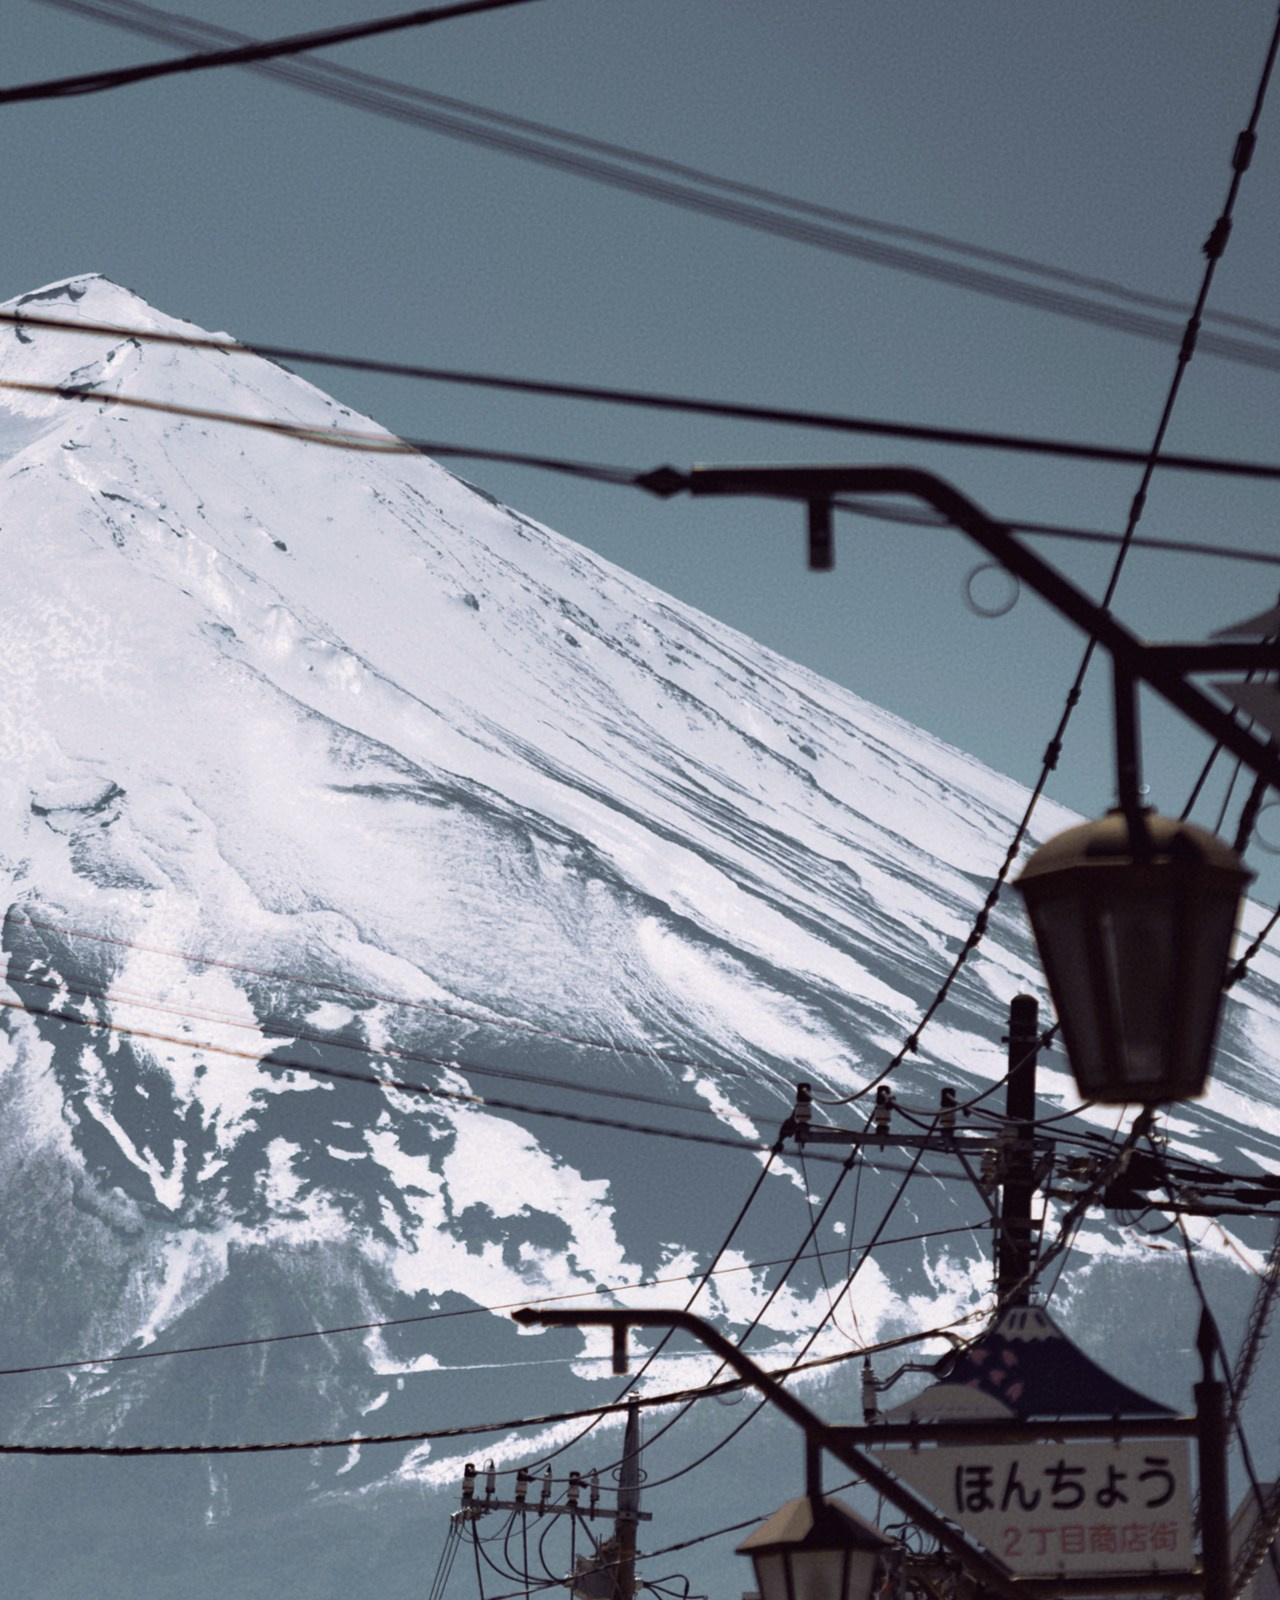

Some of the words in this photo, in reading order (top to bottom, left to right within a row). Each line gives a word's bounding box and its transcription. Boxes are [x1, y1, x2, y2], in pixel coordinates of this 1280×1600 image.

[955, 1456, 1177, 1513] ほんちょう
[1003, 1521, 1179, 1557] 2丁目商店街
